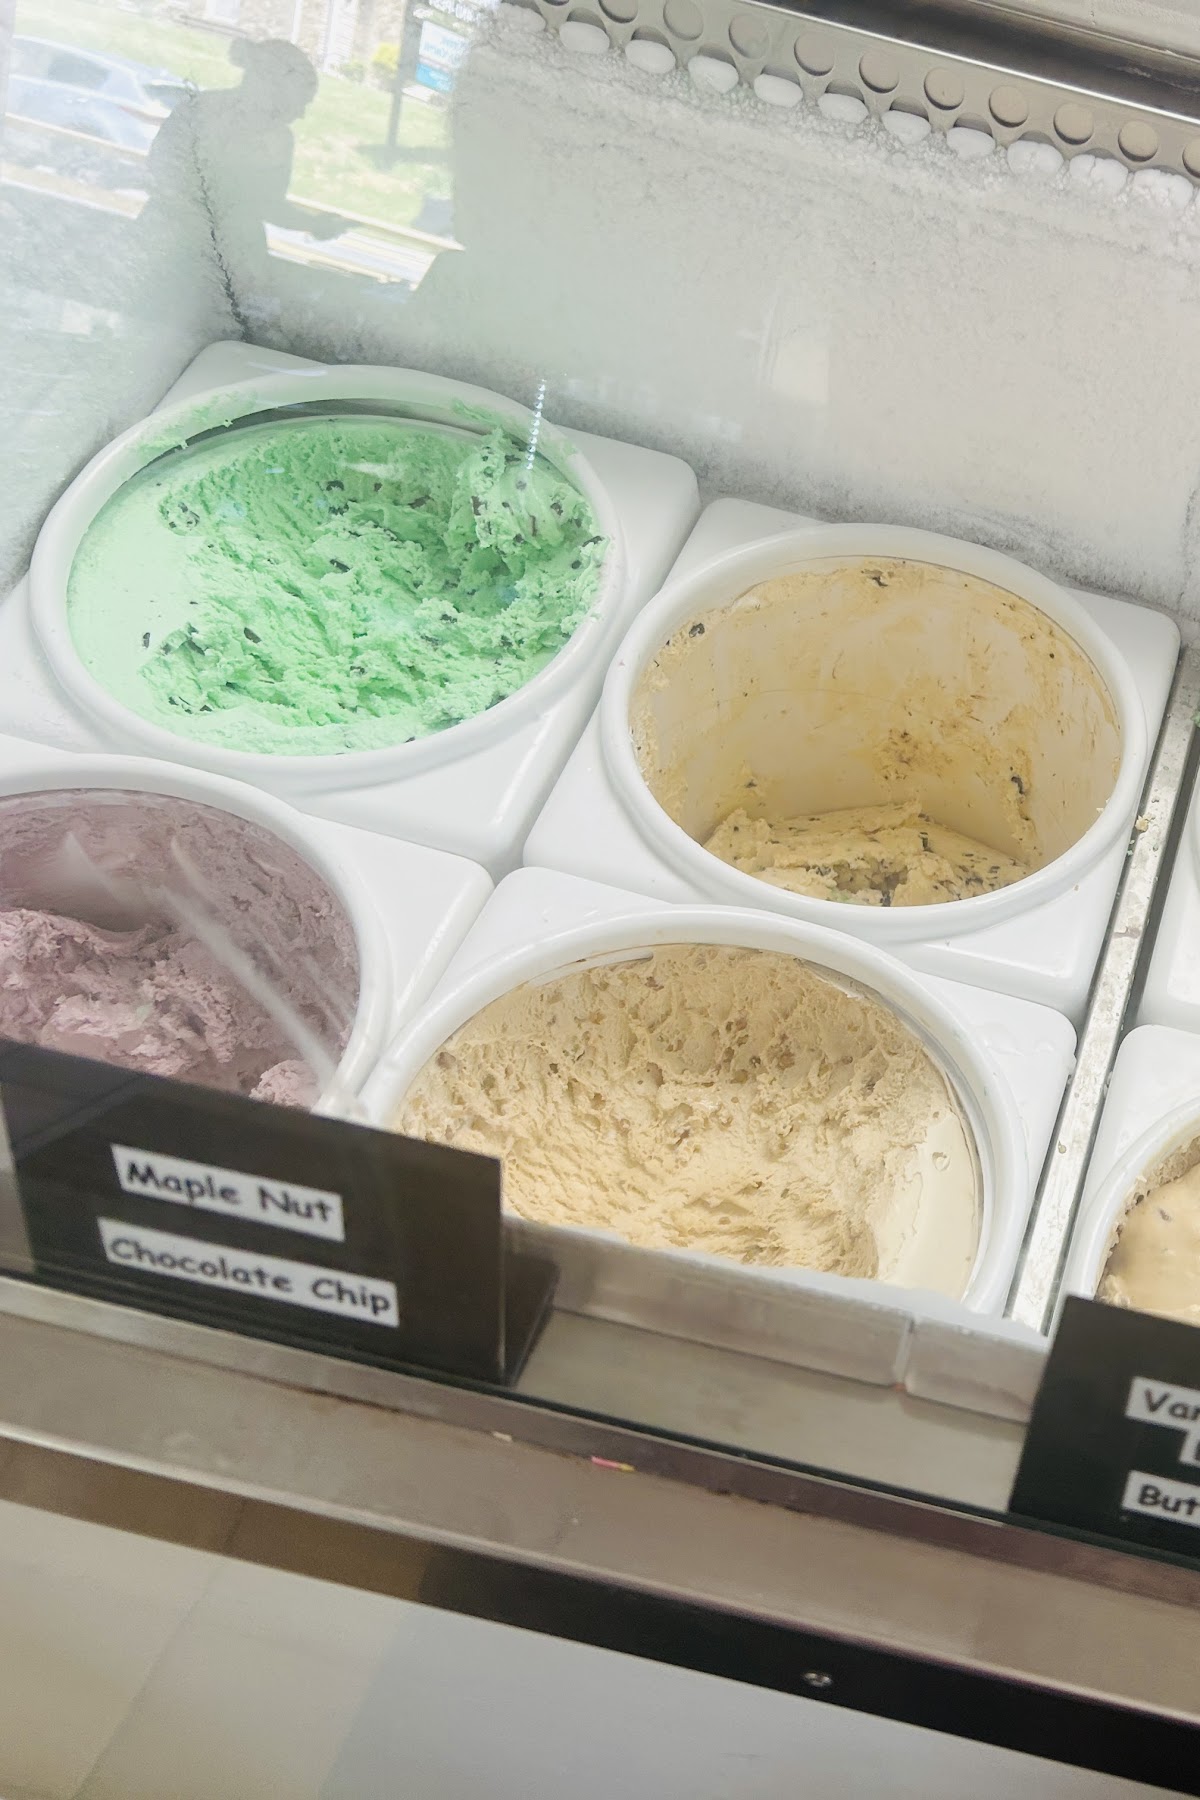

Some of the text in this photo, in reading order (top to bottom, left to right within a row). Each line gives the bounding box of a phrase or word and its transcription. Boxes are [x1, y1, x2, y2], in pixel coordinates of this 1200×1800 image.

[127, 1161, 332, 1223] Maple Nut
[111, 1237, 390, 1316] Chocolate Chip
